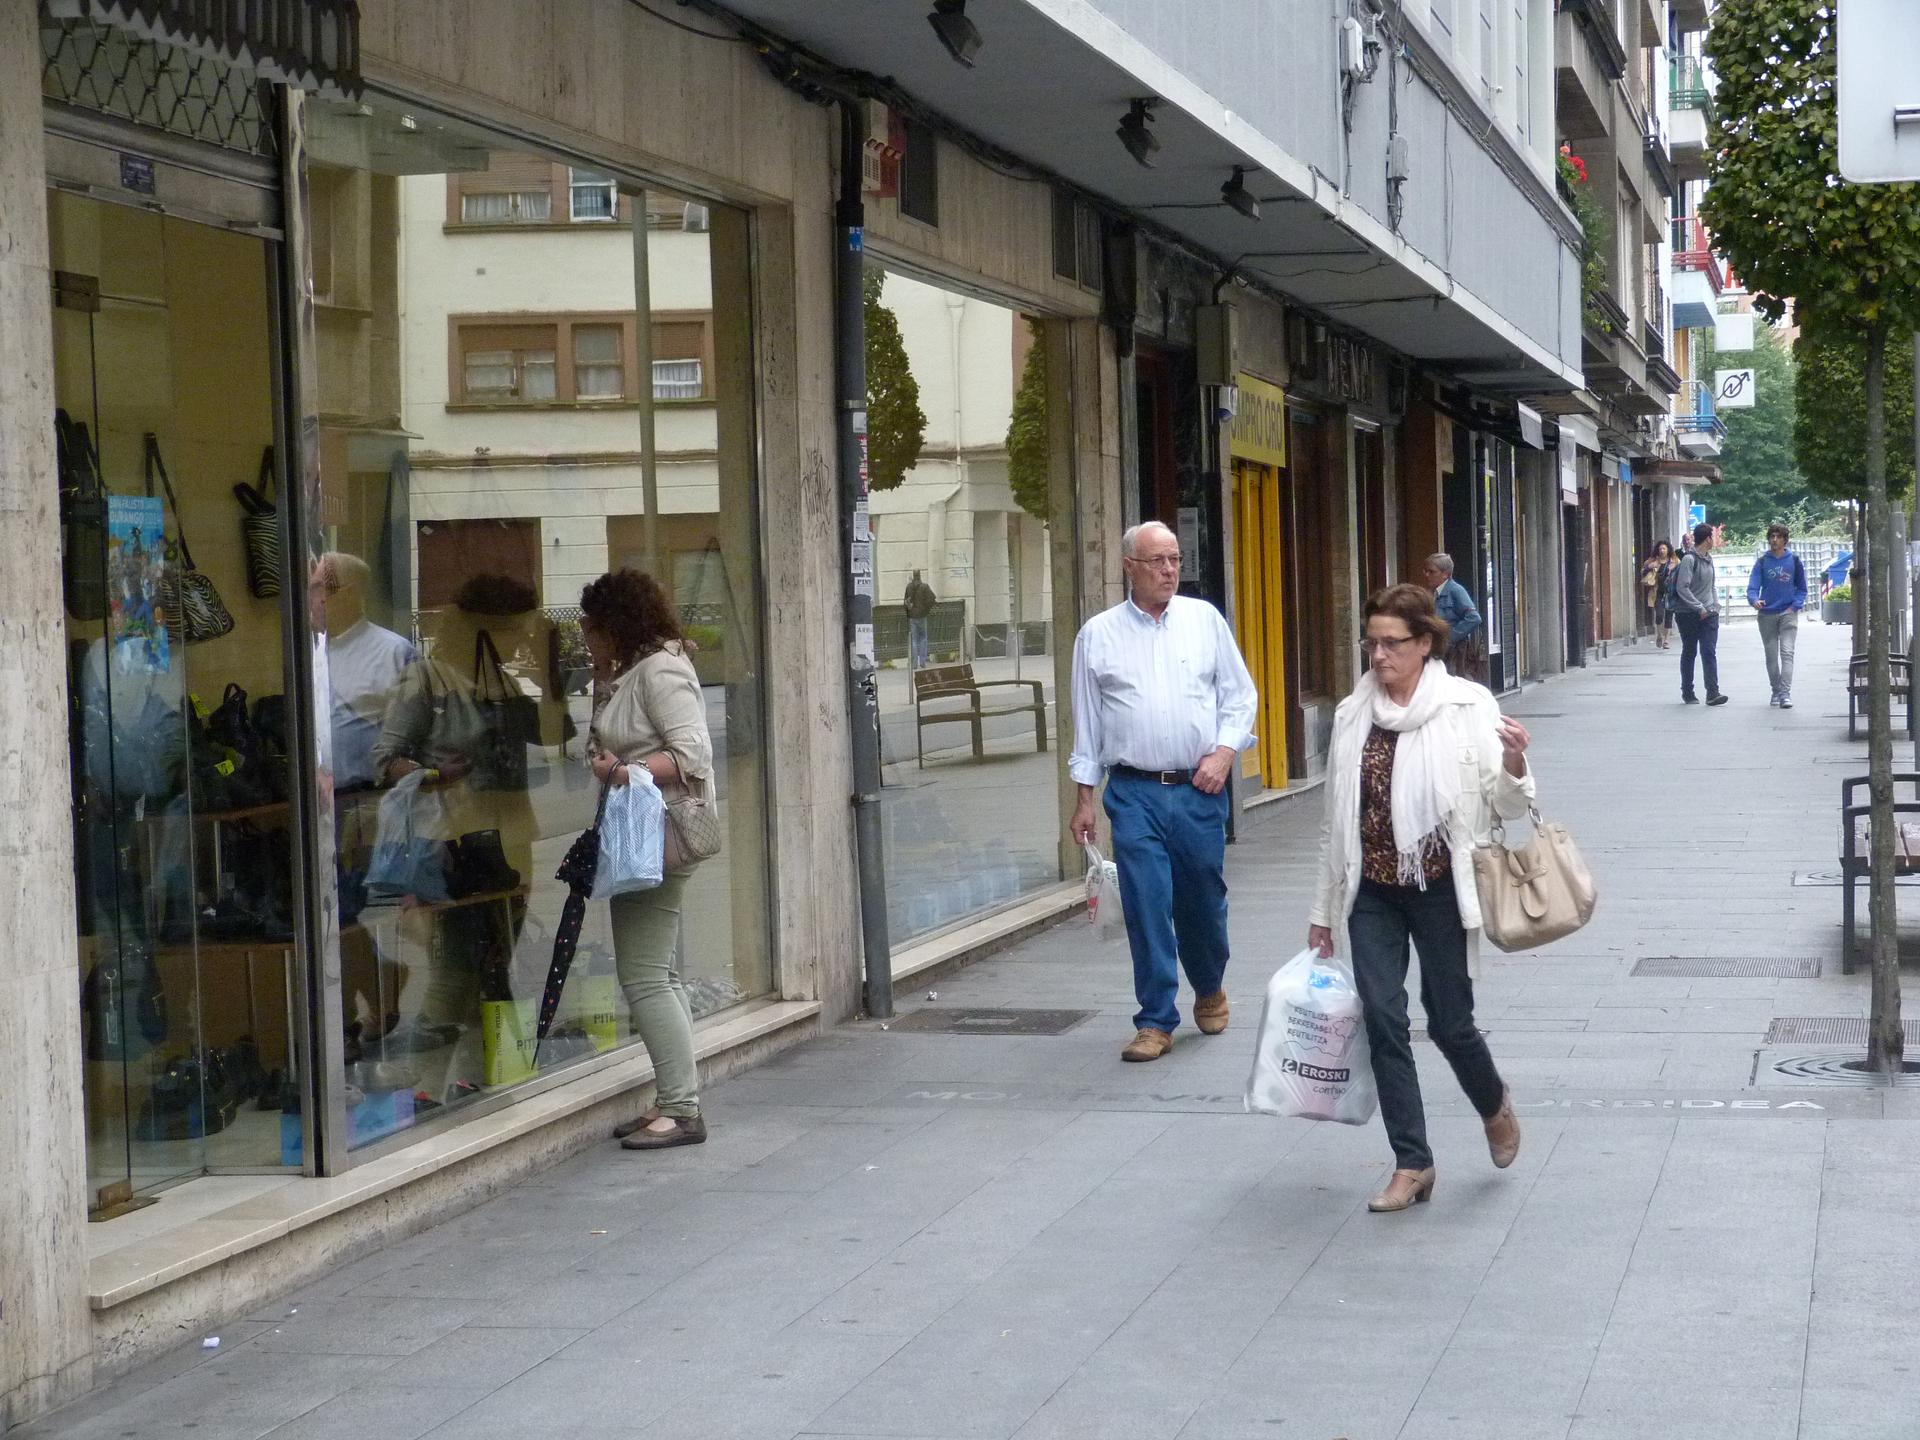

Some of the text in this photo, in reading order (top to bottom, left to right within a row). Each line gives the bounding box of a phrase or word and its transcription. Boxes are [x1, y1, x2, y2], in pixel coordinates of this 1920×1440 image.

[1231, 388, 1283, 453] OMPRO ORO
[1300, 1066, 1348, 1081] EROSKI
